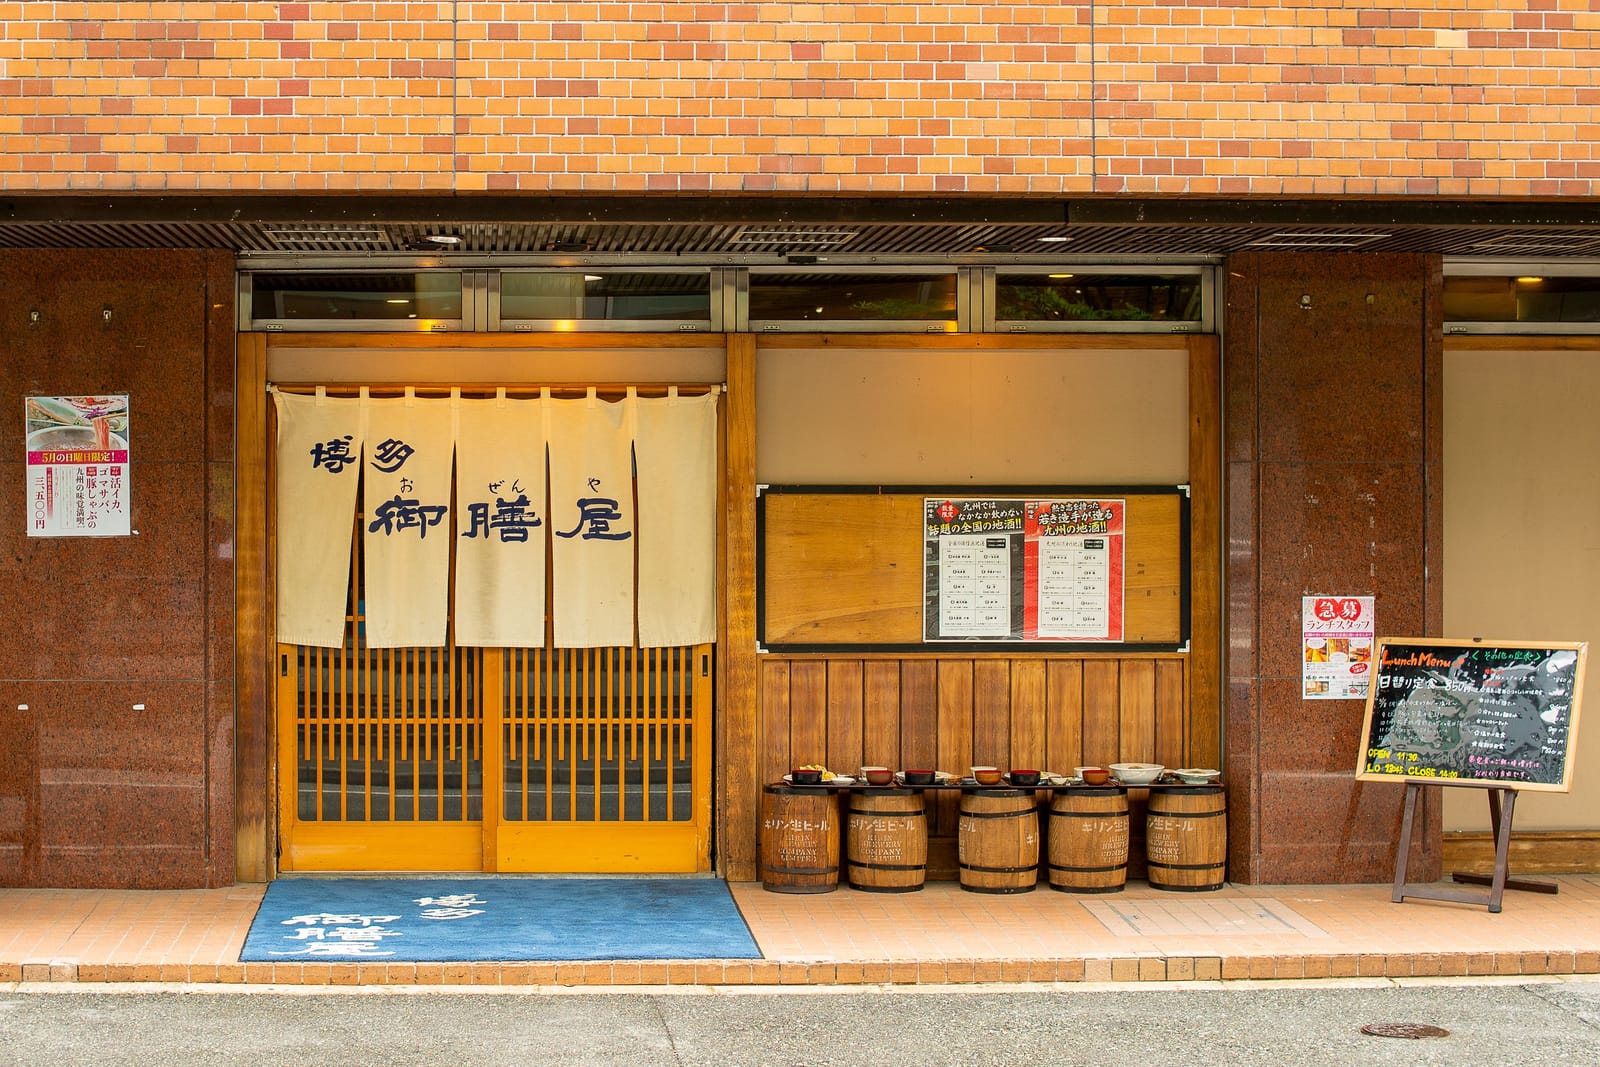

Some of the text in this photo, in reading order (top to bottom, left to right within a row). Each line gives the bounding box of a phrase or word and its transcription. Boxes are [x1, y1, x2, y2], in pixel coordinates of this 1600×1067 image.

[310, 435, 415, 474] 博多
[400, 477, 601, 494] お ぜん や
[86, 478, 97, 529] 豚しゃぶの
[963, 501, 997, 511] 九州では
[368, 494, 632, 543] 御膳屋
[958, 508, 1024, 521] なかなか飲めない
[1319, 601, 1358, 618] 急募
[1306, 620, 1370, 630] ランチスタッフ
[1382, 649, 1452, 668] Lunch Menu
[1380, 675, 1438, 690] 日替り定食
[1368, 748, 1391, 759] OPEN
[1407, 766, 1437, 777] CLOSE
[267, 913, 404, 956] 御膳屋
